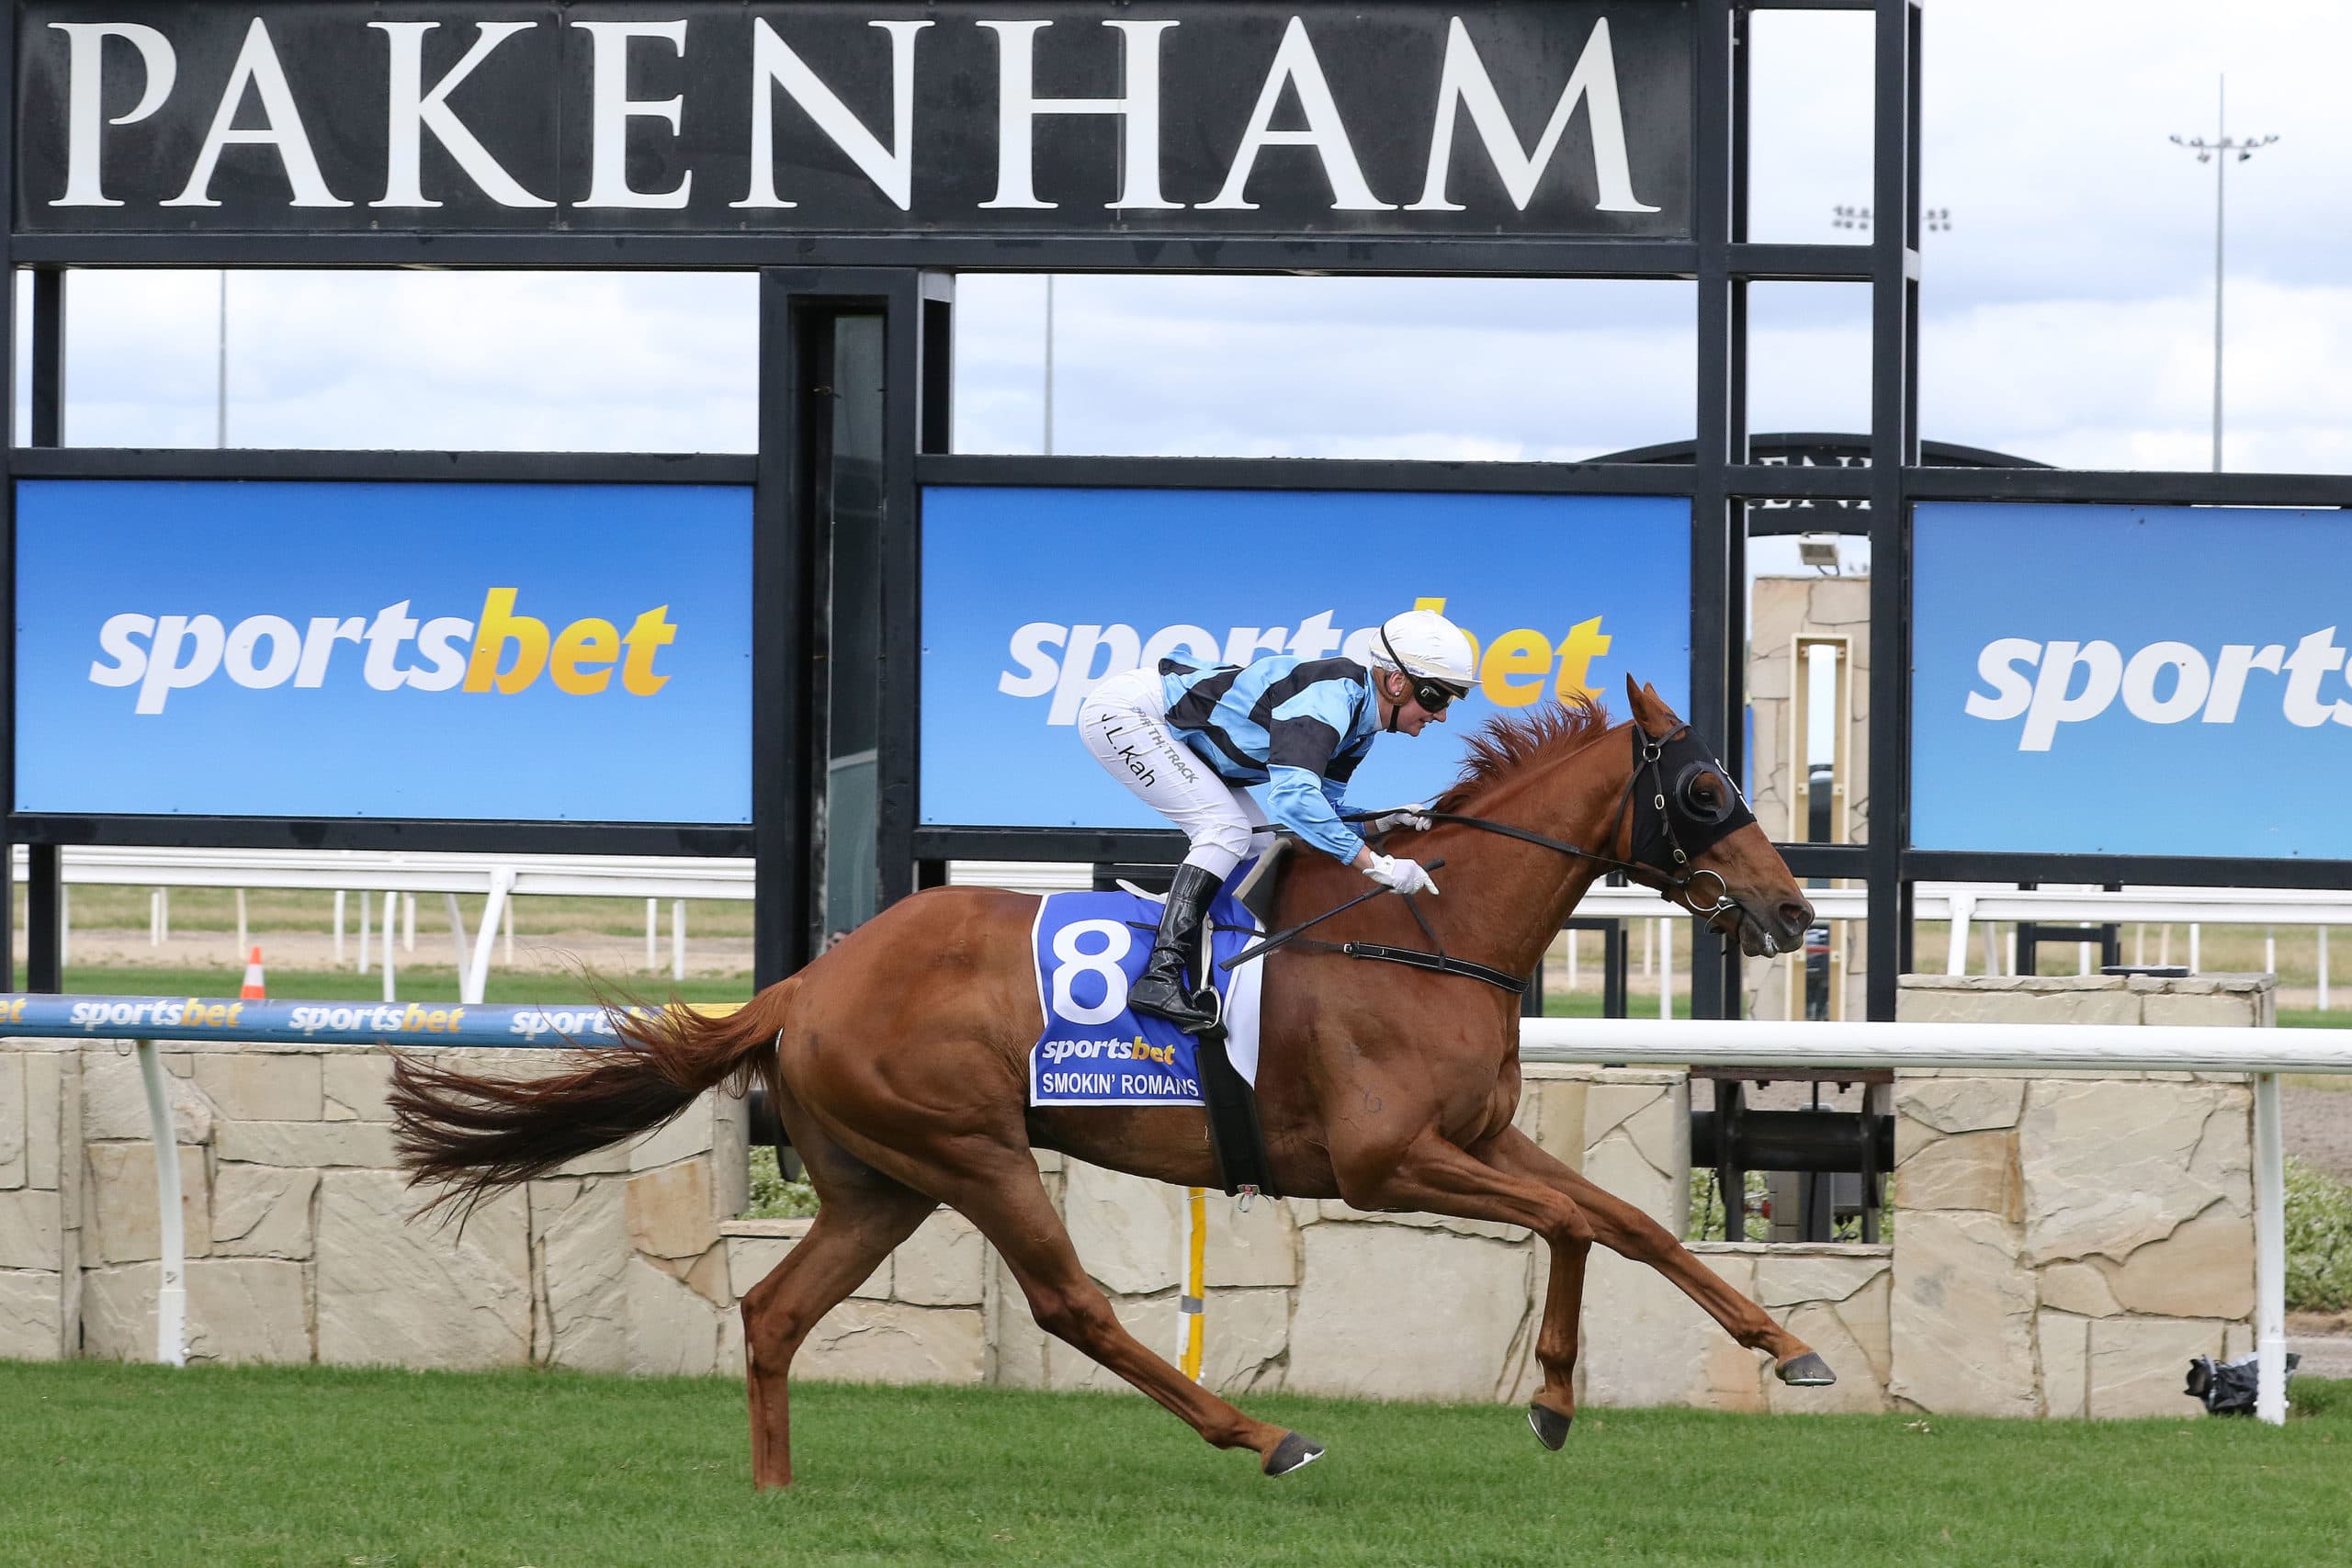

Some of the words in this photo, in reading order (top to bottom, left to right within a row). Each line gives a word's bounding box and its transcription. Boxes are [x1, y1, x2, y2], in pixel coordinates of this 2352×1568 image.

[48, 16, 1661, 212] PAKENHAM
[88, 587, 678, 715] sportsbet
[1964, 625, 2352, 751] sport
[1164, 746, 1199, 784] TRACK
[1052, 919, 1132, 1024] 8
[70, 998, 244, 1032] sportsbet
[288, 1002, 465, 1036] sportsbet
[1042, 1036, 1176, 1065] sportsbet
[1042, 1073, 1115, 1094] SMOKIN'
[1121, 1074, 1199, 1097] ROMANS
